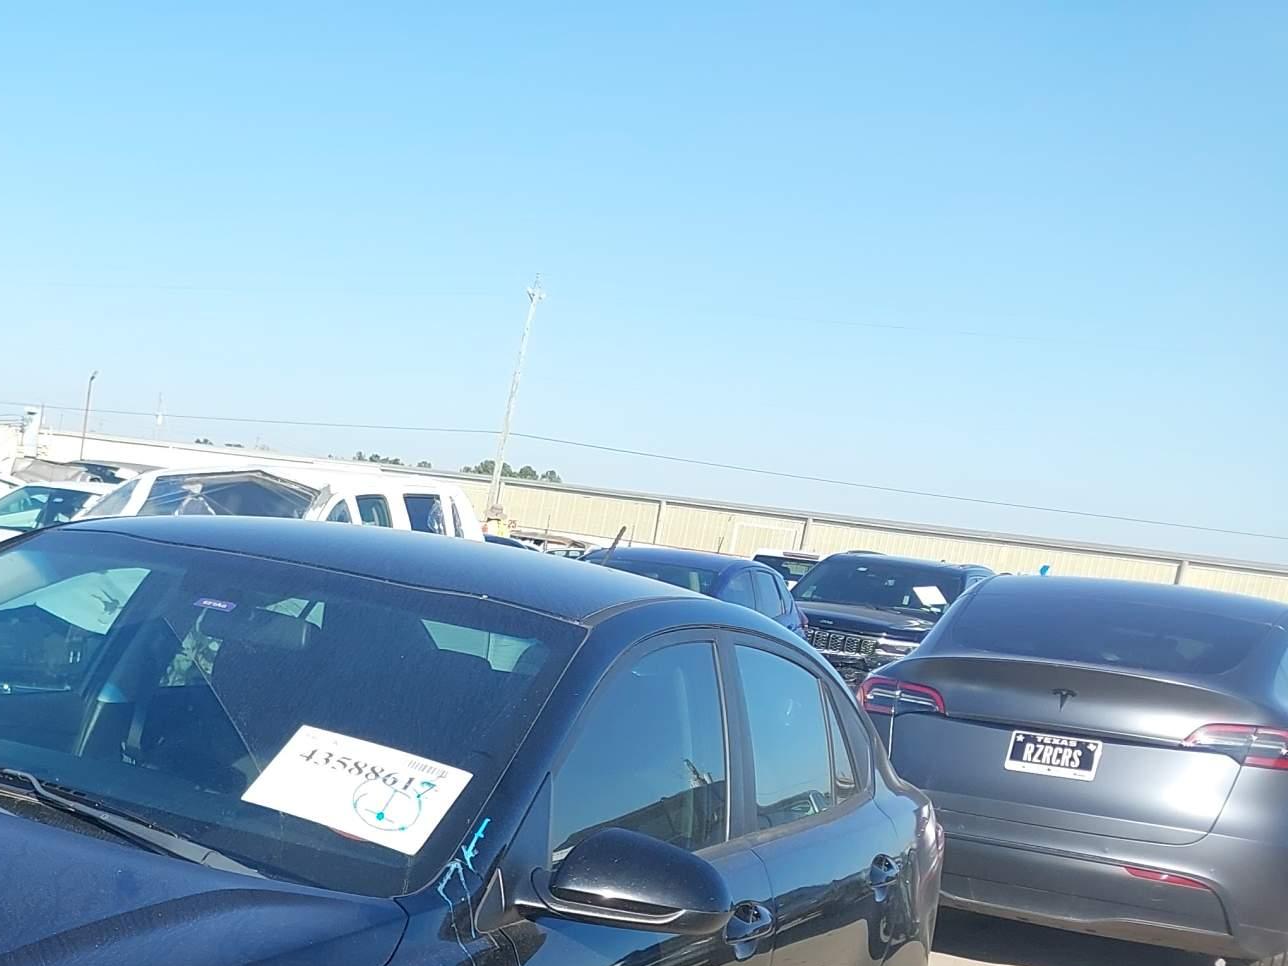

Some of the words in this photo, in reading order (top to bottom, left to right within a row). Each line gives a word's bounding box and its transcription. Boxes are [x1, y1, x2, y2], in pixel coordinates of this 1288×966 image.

[1036, 735, 1078, 748] TEXAS
[1023, 742, 1083, 769] RZRCRS
[299, 748, 437, 798] 43588617
